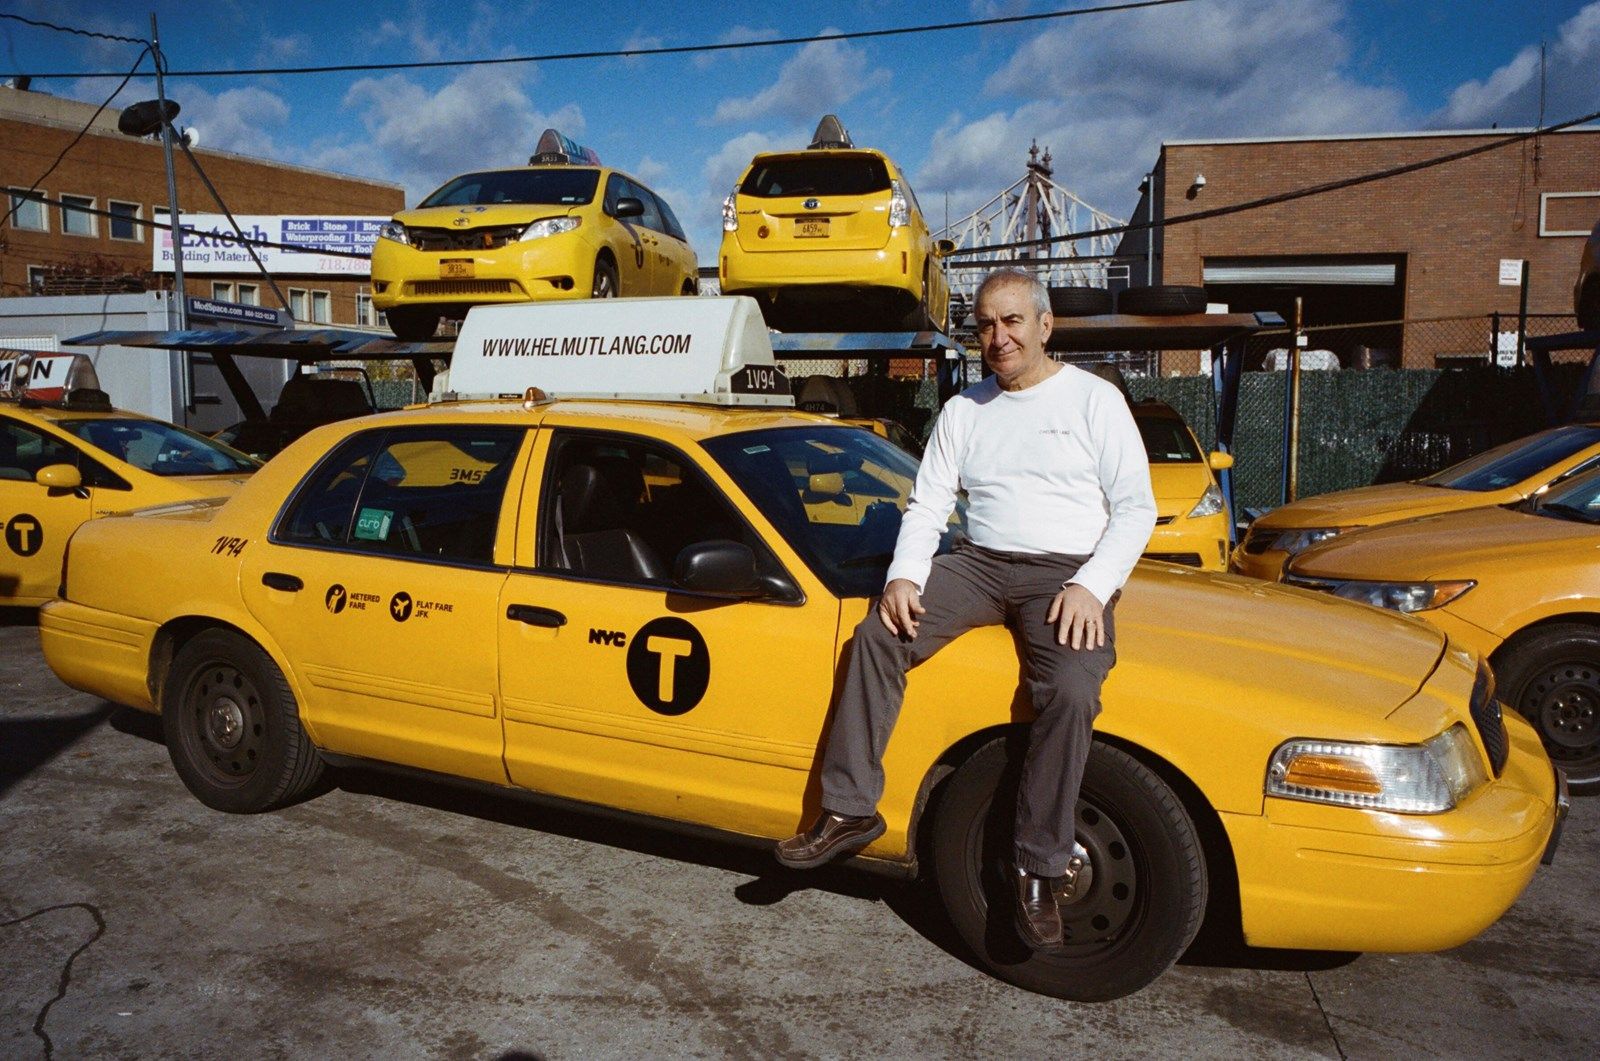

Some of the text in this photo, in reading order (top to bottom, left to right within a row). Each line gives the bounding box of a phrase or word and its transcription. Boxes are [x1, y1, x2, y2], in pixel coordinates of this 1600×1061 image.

[287, 222, 311, 231] Brick
[322, 222, 348, 231] Stone
[286, 233, 346, 243] Waterproofing
[193, 301, 243, 316] ModSpace.com
[482, 334, 692, 357] WWW.HELMUTLANG.COM
[746, 369, 776, 390] 1V94
[210, 535, 249, 558] 1V94
[350, 592, 381, 603] METERED
[348, 601, 366, 610] FARE
[416, 600, 454, 613] FLAT FARE
[414, 610, 429, 618] JFK
[588, 627, 693, 704] NYC T
